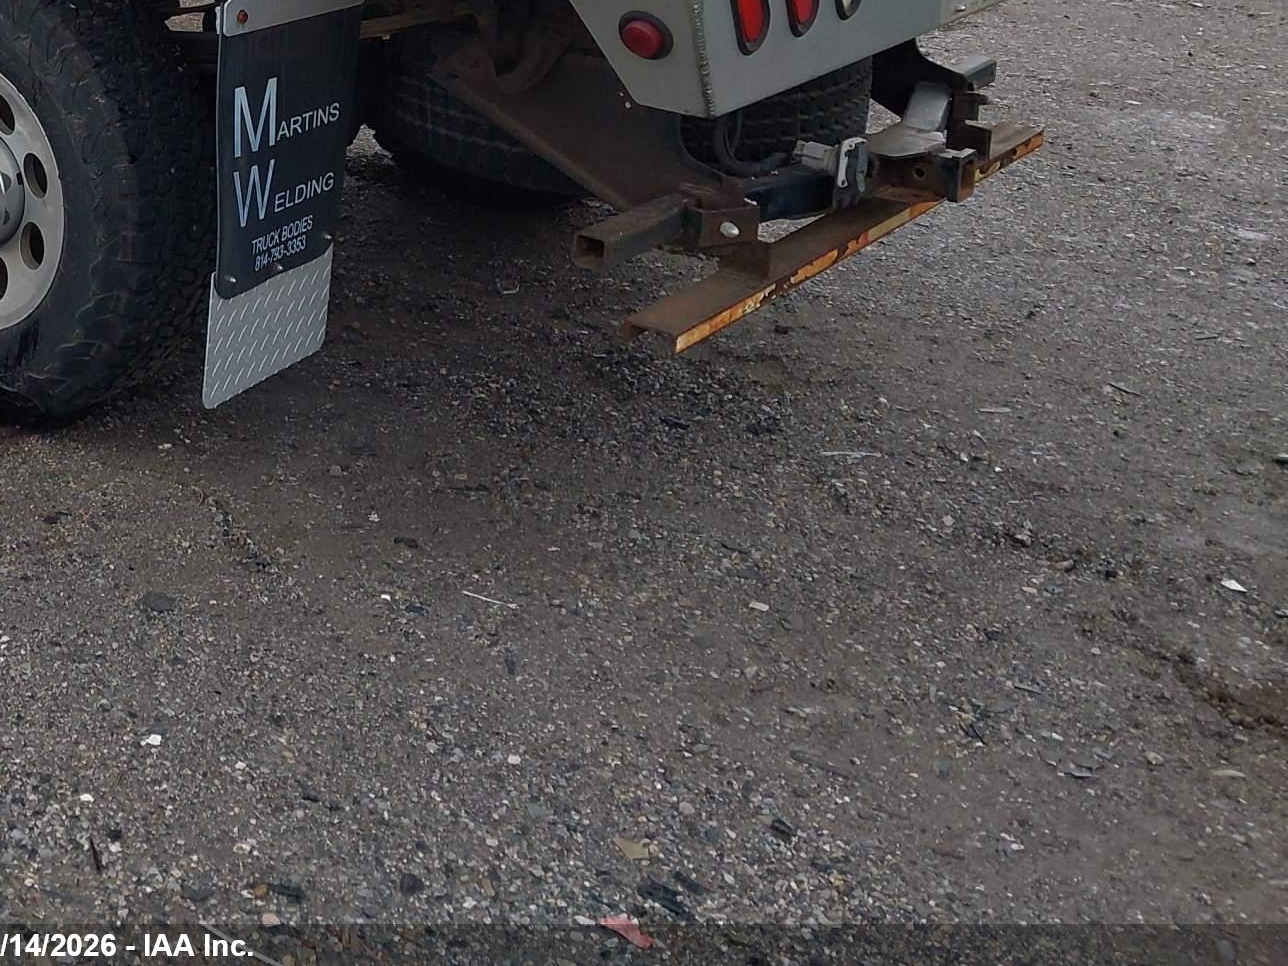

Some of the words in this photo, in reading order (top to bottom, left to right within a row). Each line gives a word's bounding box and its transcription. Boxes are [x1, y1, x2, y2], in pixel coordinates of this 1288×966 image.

[252, 226, 281, 256] TRUCK
[281, 215, 313, 243] BODIES
[254, 234, 307, 272] 814-793-3353
